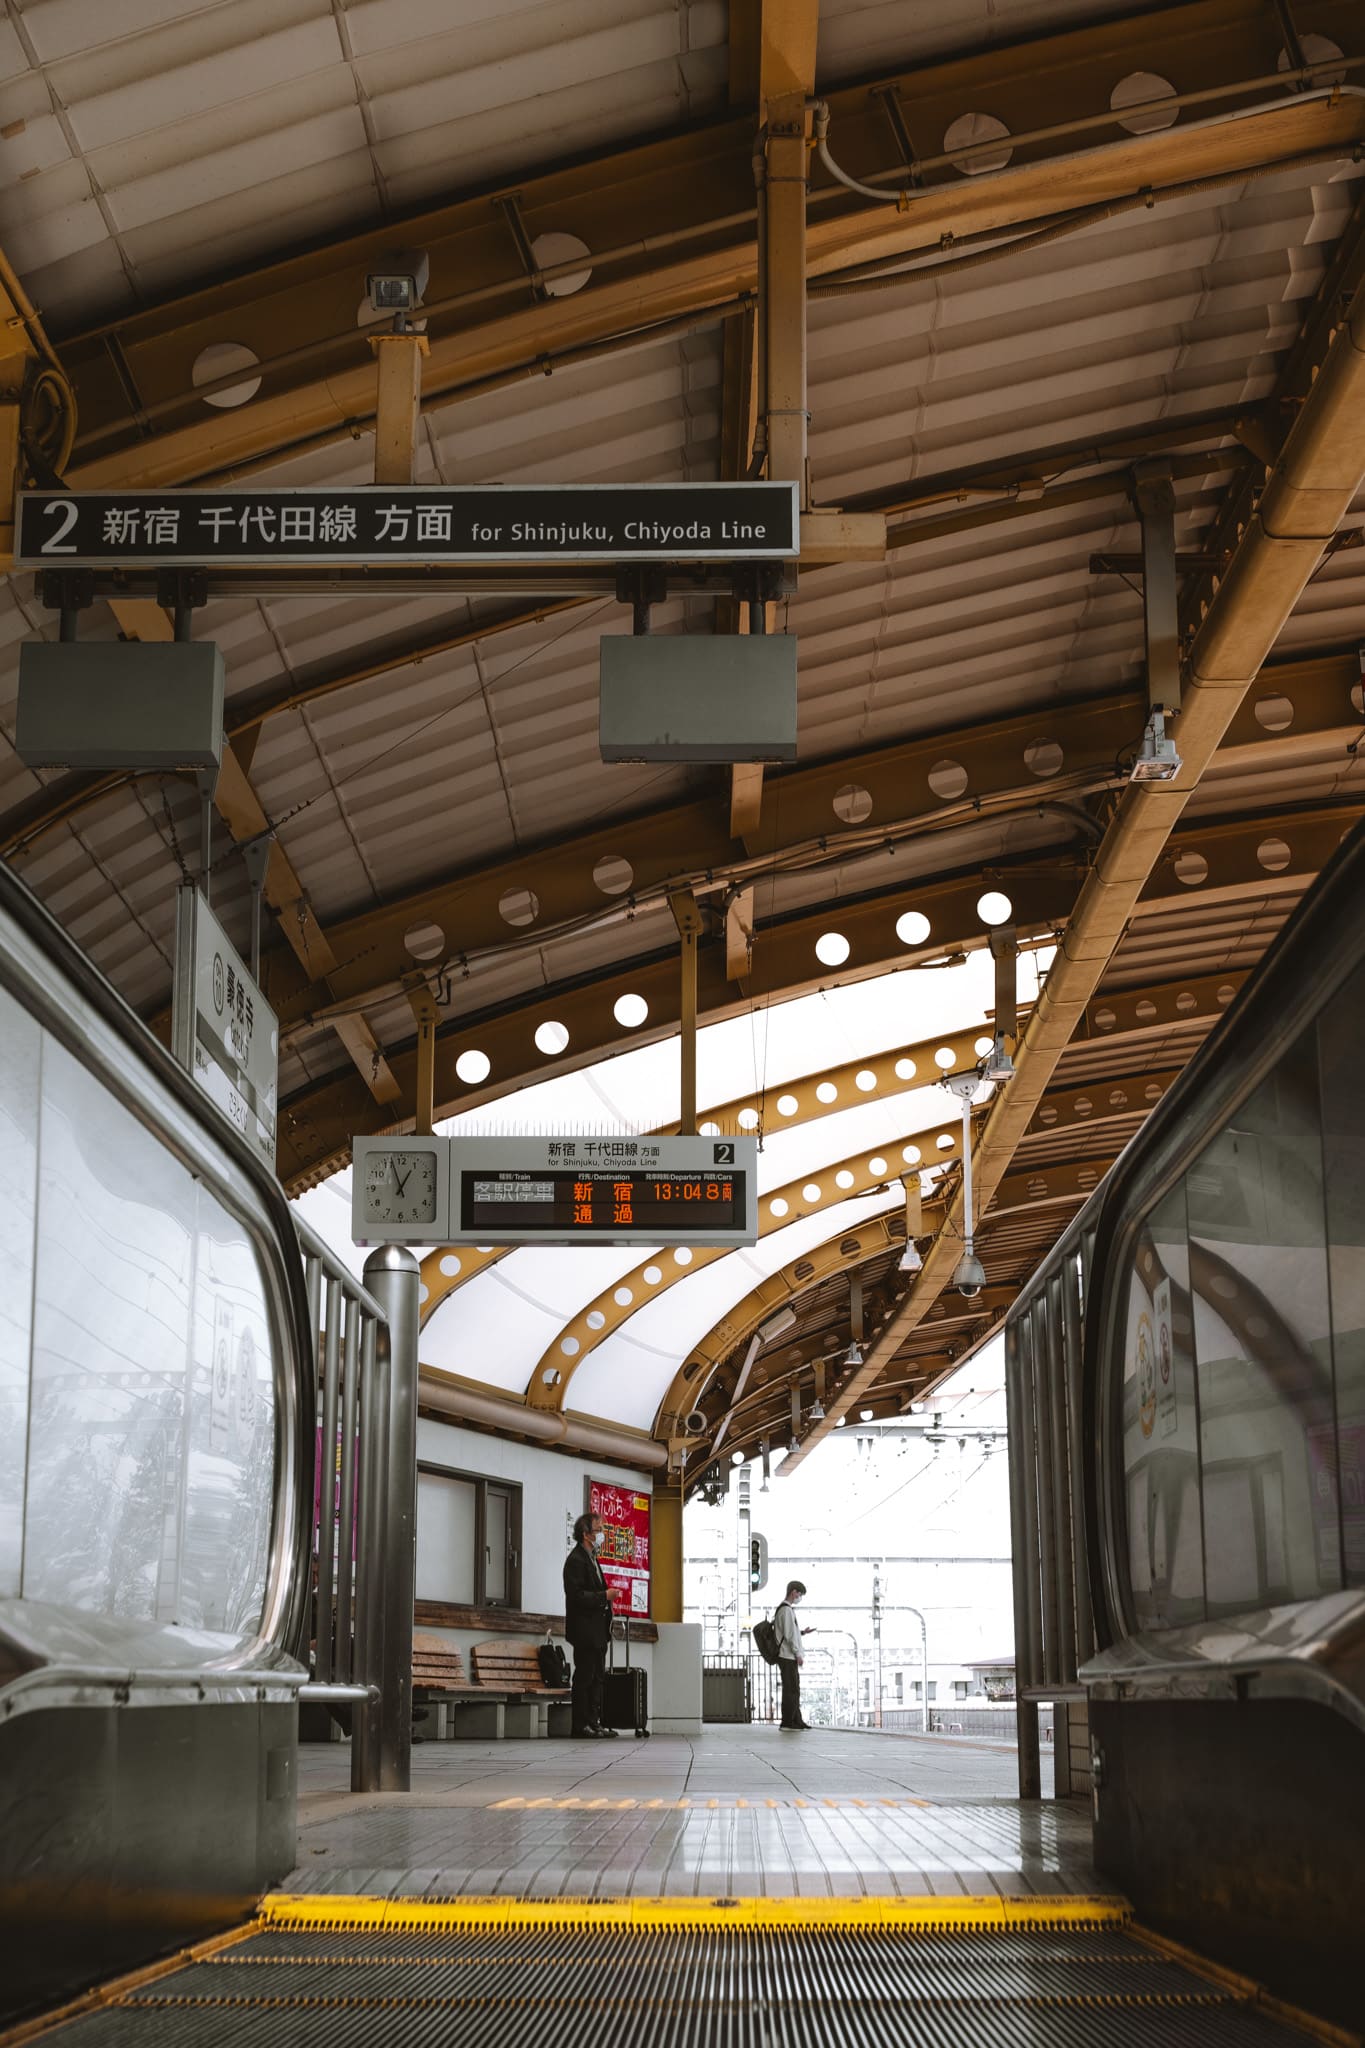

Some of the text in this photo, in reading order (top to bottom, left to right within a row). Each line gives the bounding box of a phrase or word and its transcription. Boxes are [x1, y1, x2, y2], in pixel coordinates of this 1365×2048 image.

[41, 500, 767, 553] 2 新宿 千代田線 方面 for Shinjuku, Chiyoda Line
[548, 1142, 660, 1157] 新宿 千代田線 方面
[717, 1144, 730, 1163] 2
[397, 1157, 407, 1166] 12
[413, 1161, 417, 1170] 1
[563, 1159, 600, 1168] Shinjuku,
[603, 1159, 637, 1168] Chiyoda
[374, 1170, 385, 1178] 10
[422, 1170, 428, 1179] 2
[370, 1184, 377, 1193] 9
[426, 1184, 433, 1193] 3
[475, 1182, 554, 1201] 各駅停車
[573, 1182, 633, 1202] 新宿
[654, 1183, 702, 1200] 13:04
[421, 1199, 427, 1207] 4
[385, 1208, 391, 1216] 7
[397, 1212, 404, 1220] 6
[412, 1208, 418, 1216] 5
[573, 1204, 633, 1224] 通過
